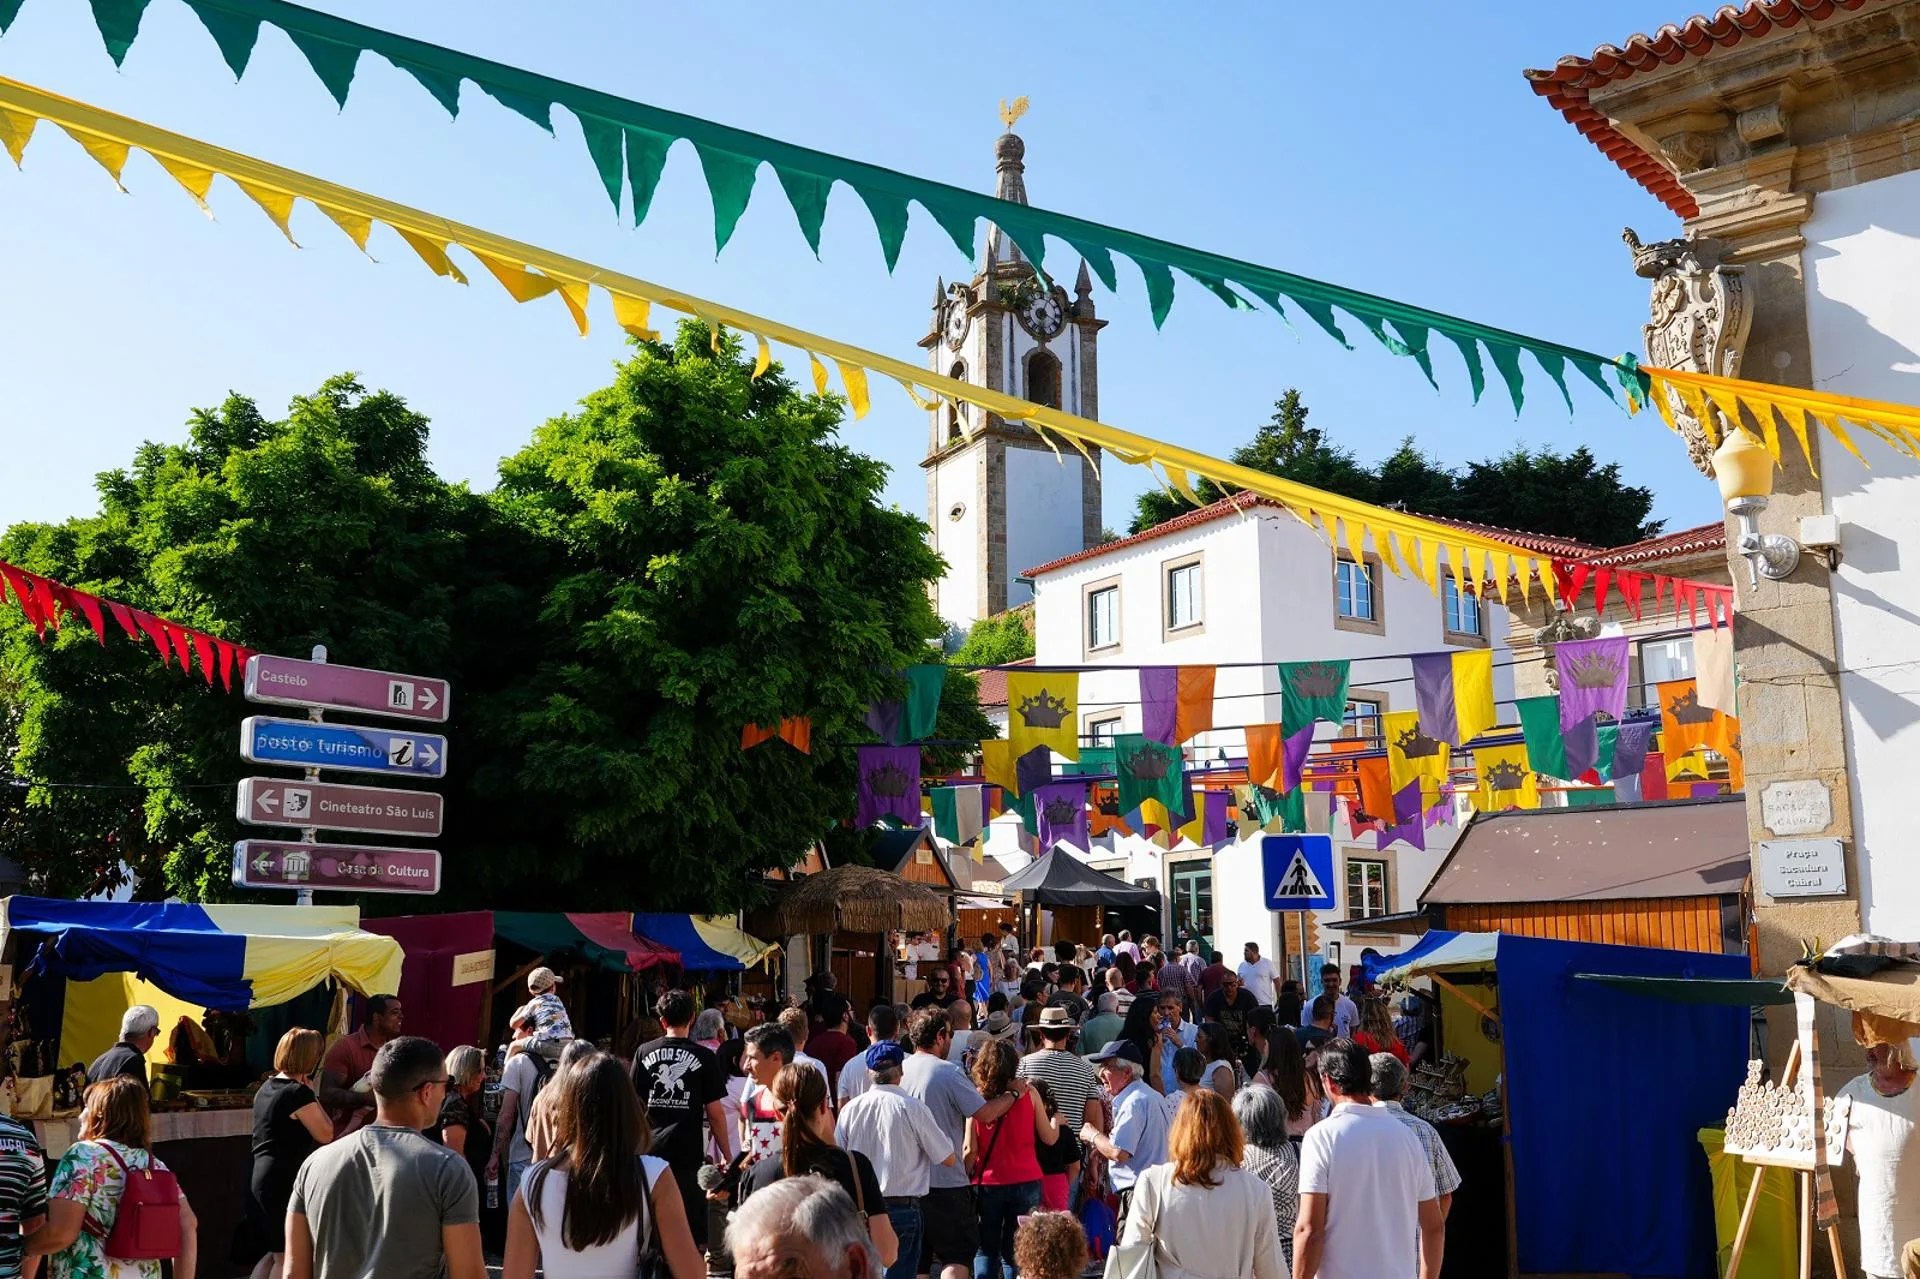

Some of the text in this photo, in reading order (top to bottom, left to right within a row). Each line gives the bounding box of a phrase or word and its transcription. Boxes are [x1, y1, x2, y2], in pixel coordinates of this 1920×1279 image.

[260, 670, 308, 688] Castelo
[319, 799, 383, 816] Cineteatro
[386, 805, 408, 818] São
[387, 864, 429, 878] Cultura
[642, 1048, 702, 1071] MOTOR SHOW
